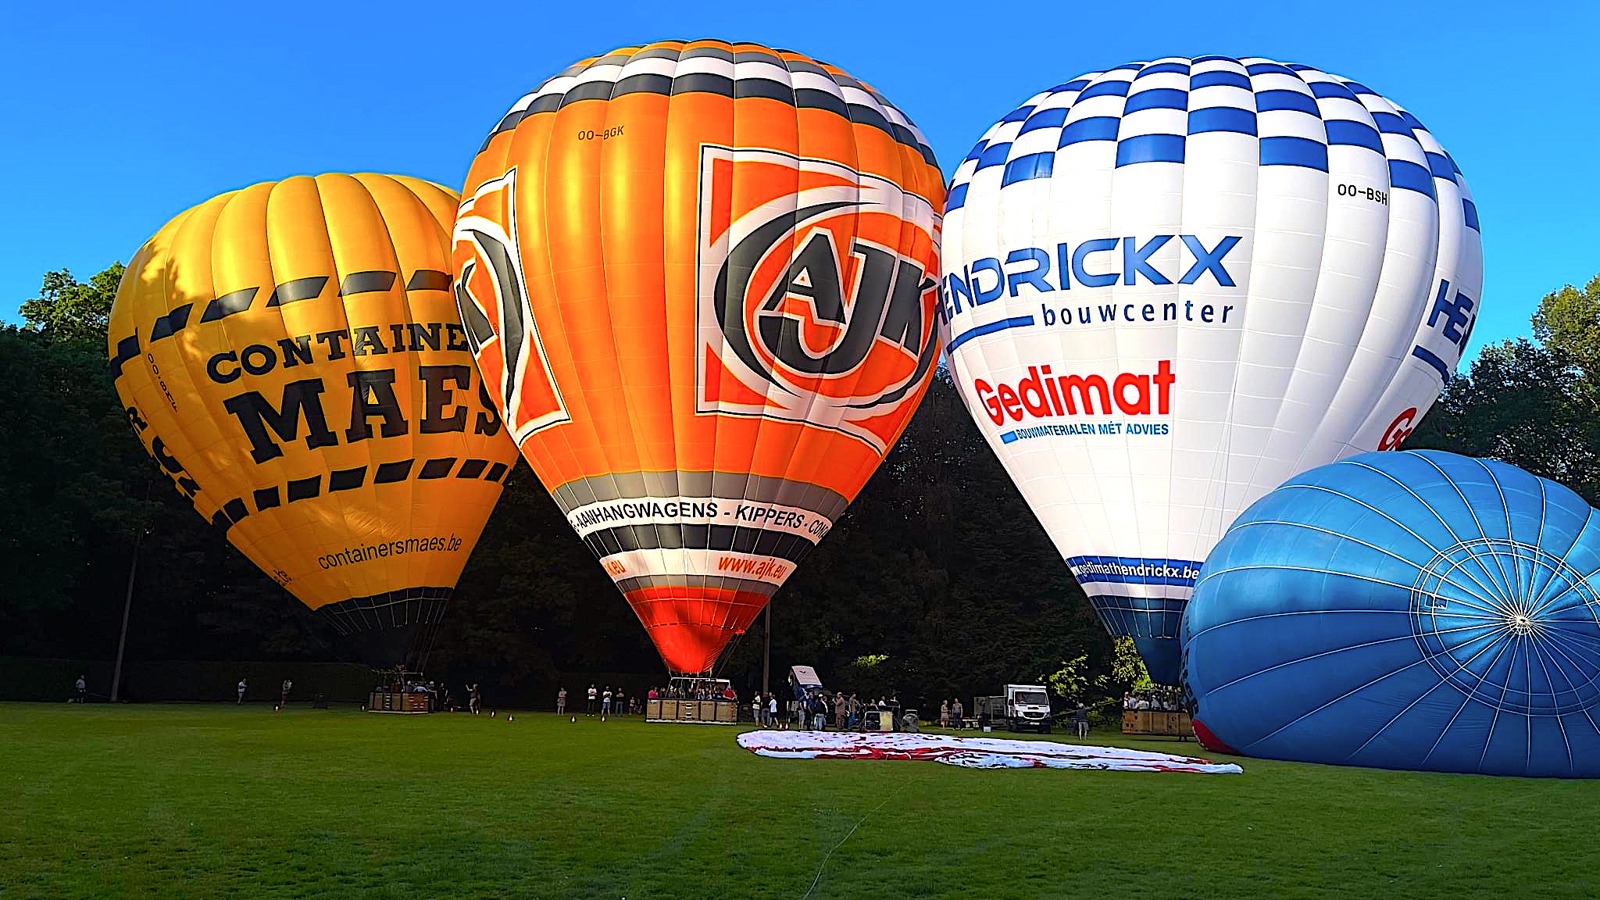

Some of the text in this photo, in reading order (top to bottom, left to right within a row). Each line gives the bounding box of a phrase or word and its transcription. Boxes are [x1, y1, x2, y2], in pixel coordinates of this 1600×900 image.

[578, 125, 624, 141] OO-BGK
[1337, 183, 1388, 206] OO-BSH
[758, 232, 938, 374] AJK
[1041, 300, 1234, 327] bouwcenter
[974, 359, 1176, 427] Gedimat
[1016, 420, 1169, 440] BOUWMATERIALEN MÉT ADVIES
[735, 504, 805, 529] KIPPERS
[318, 533, 462, 570] containersmaes.be
[718, 556, 788, 579] www.ajk.eu
